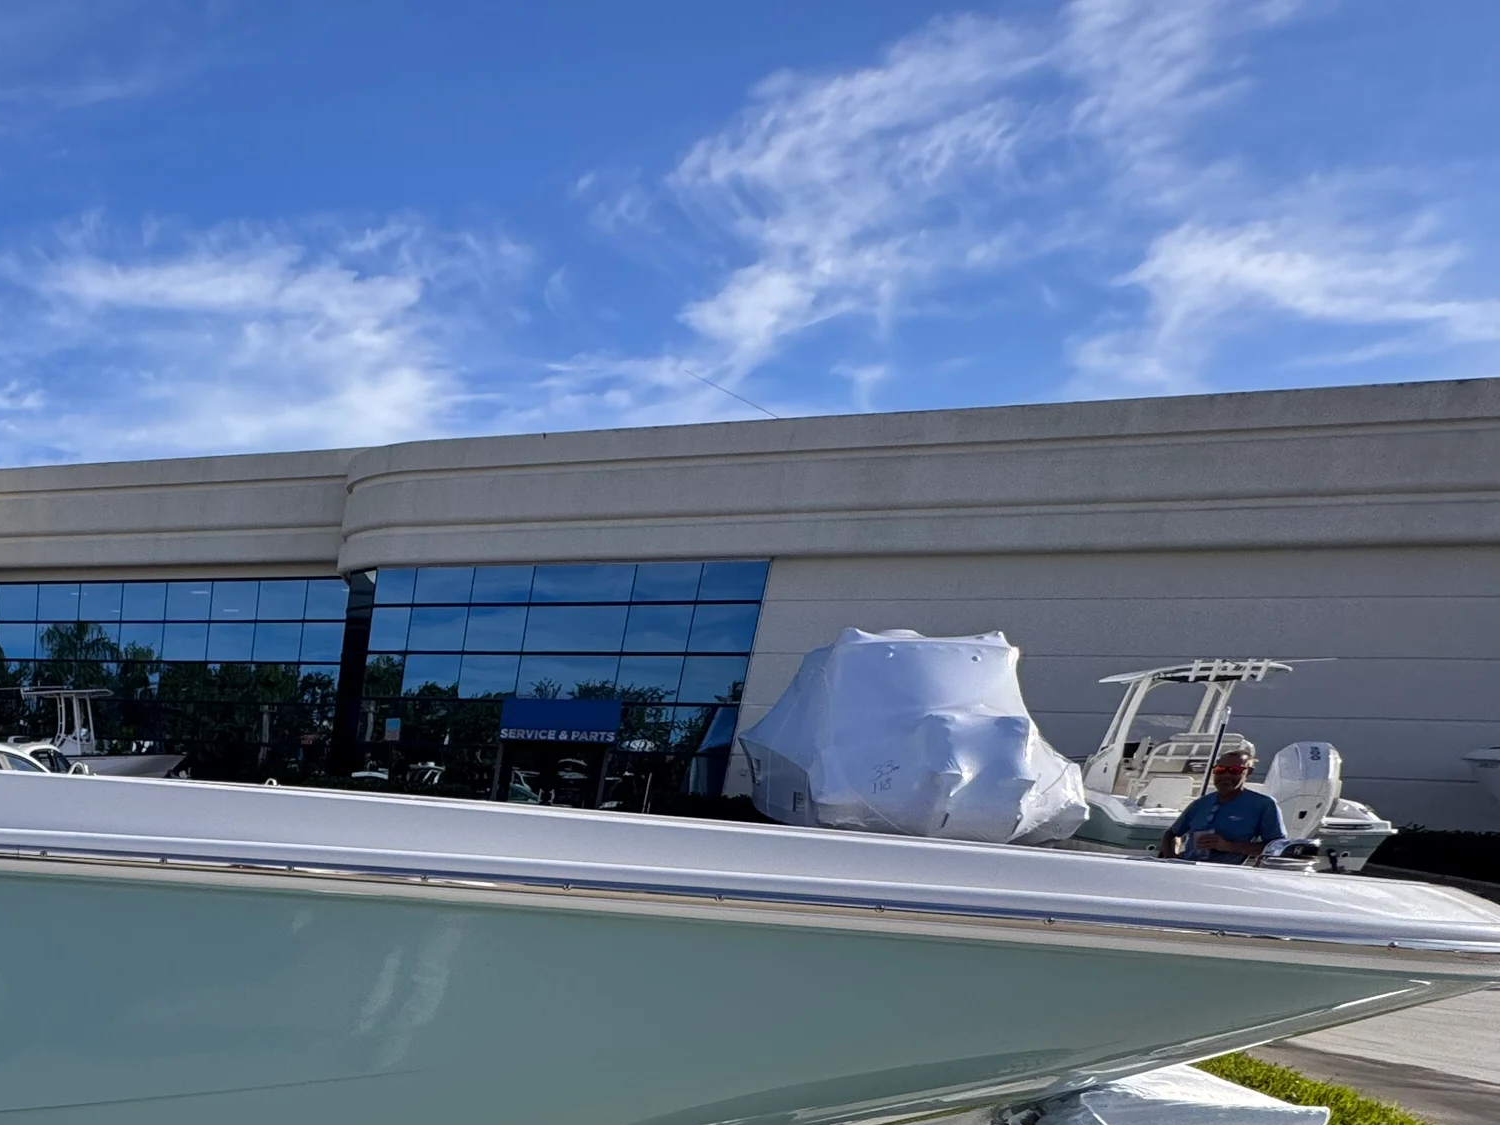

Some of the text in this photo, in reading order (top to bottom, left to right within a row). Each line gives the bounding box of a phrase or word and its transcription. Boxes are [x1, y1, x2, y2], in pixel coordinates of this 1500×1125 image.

[499, 728, 616, 742] SERVICE & PARTS
